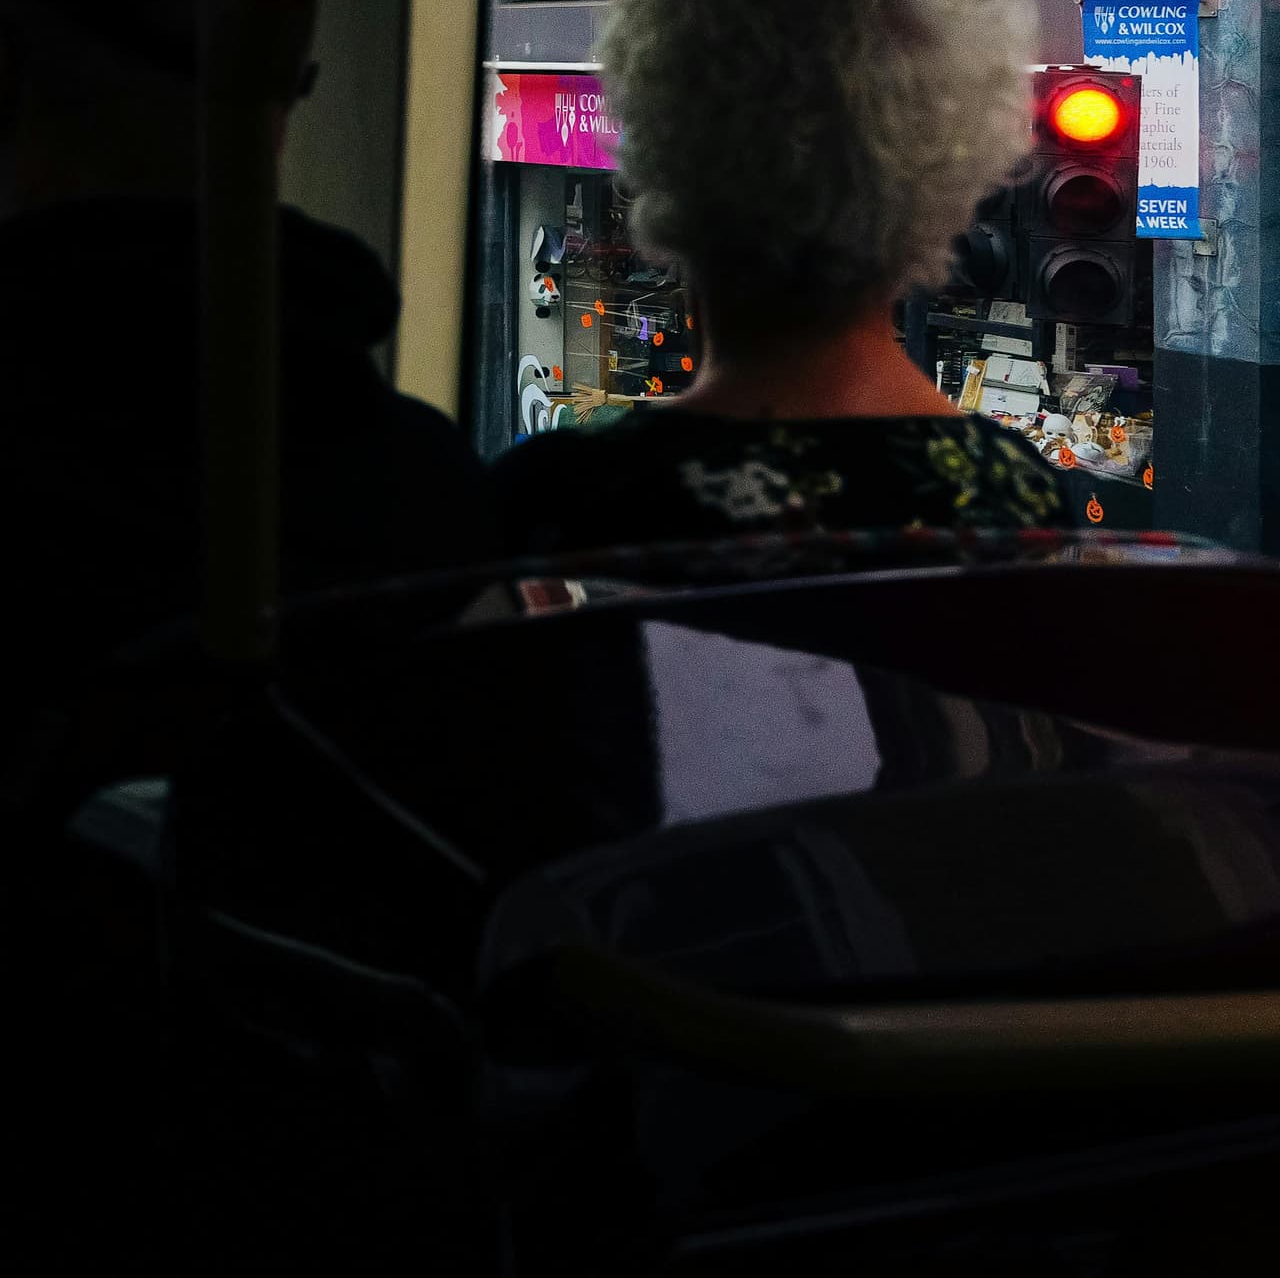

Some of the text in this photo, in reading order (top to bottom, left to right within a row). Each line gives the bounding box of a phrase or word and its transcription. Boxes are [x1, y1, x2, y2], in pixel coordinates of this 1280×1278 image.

[1118, 6, 1187, 19] COWLING
[1130, 22, 1185, 35] WILCOX
[1166, 83, 1181, 98] of
[1155, 102, 1181, 115] Fine
[1142, 119, 1176, 137] aphic
[1140, 137, 1183, 151] aterials
[1144, 155, 1177, 168] 1960.
[1139, 199, 1187, 213] SEVEN
[1146, 216, 1189, 229] WEEK
